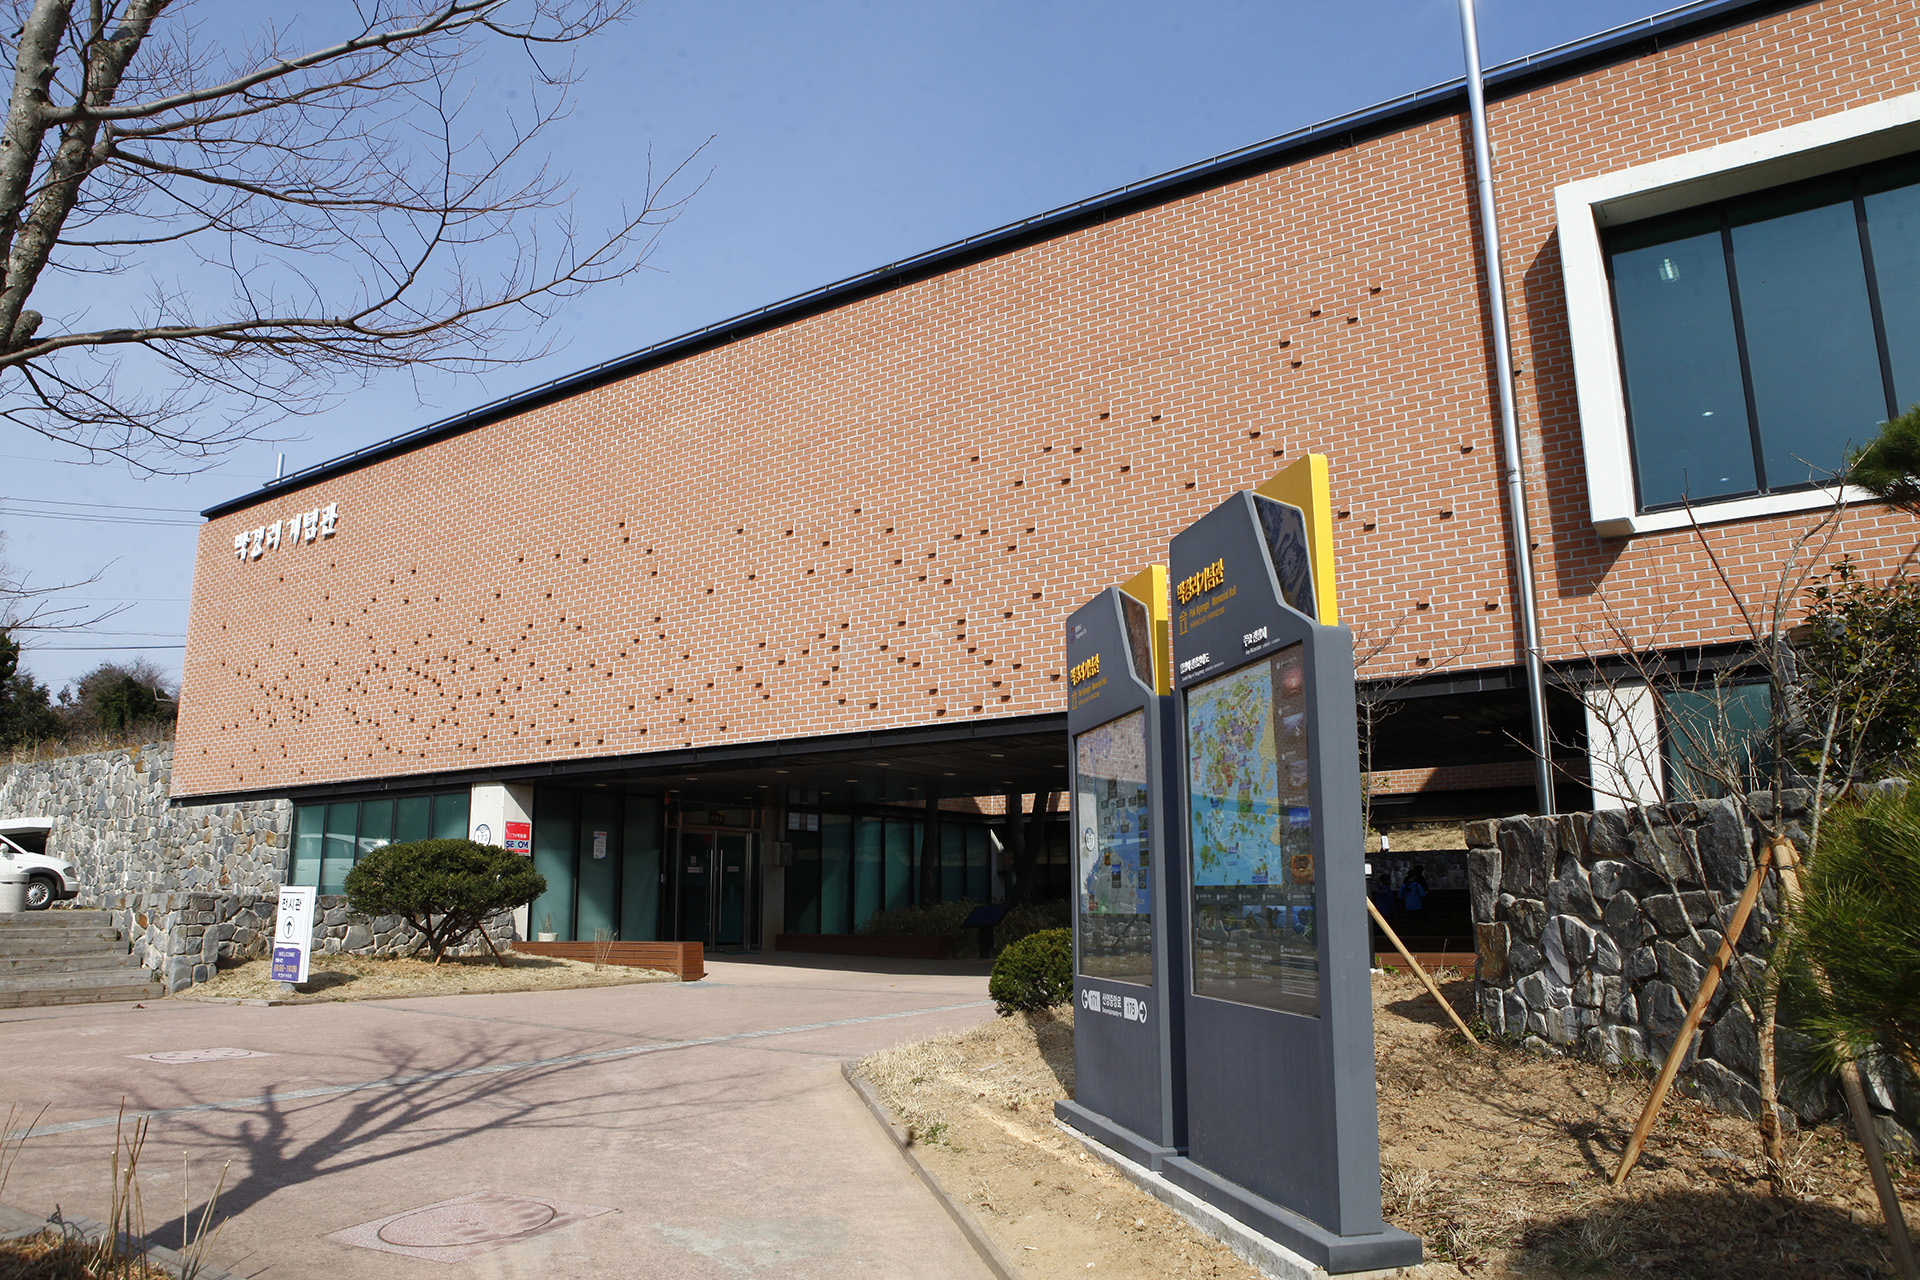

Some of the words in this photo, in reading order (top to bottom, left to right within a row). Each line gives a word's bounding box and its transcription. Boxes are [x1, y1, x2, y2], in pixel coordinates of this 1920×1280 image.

[477, 833, 488, 842] 173
[506, 840, 529, 848] SECOM
[282, 897, 302, 911] 전시관
[1126, 1002, 1136, 1016] 175
